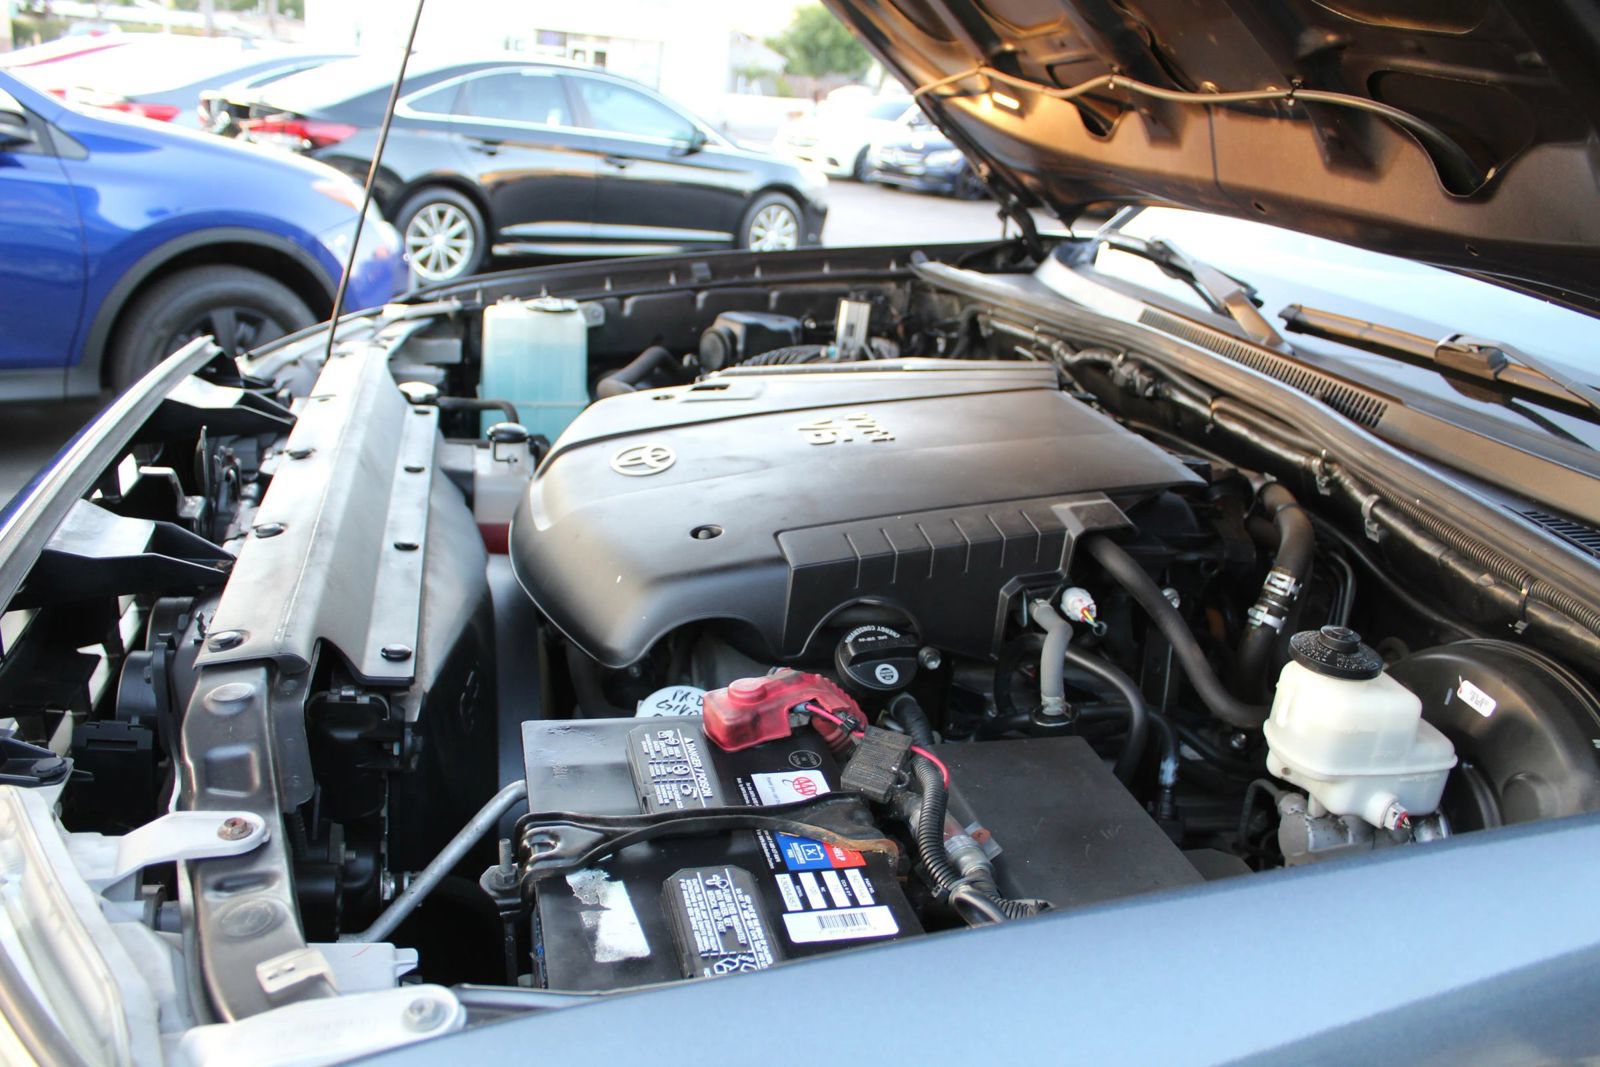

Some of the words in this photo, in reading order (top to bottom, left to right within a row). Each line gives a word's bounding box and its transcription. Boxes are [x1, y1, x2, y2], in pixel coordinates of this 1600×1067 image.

[844, 625, 876, 643] CONSERVING
[876, 625, 901, 638] ENERGY
[794, 777, 816, 795] AAA
